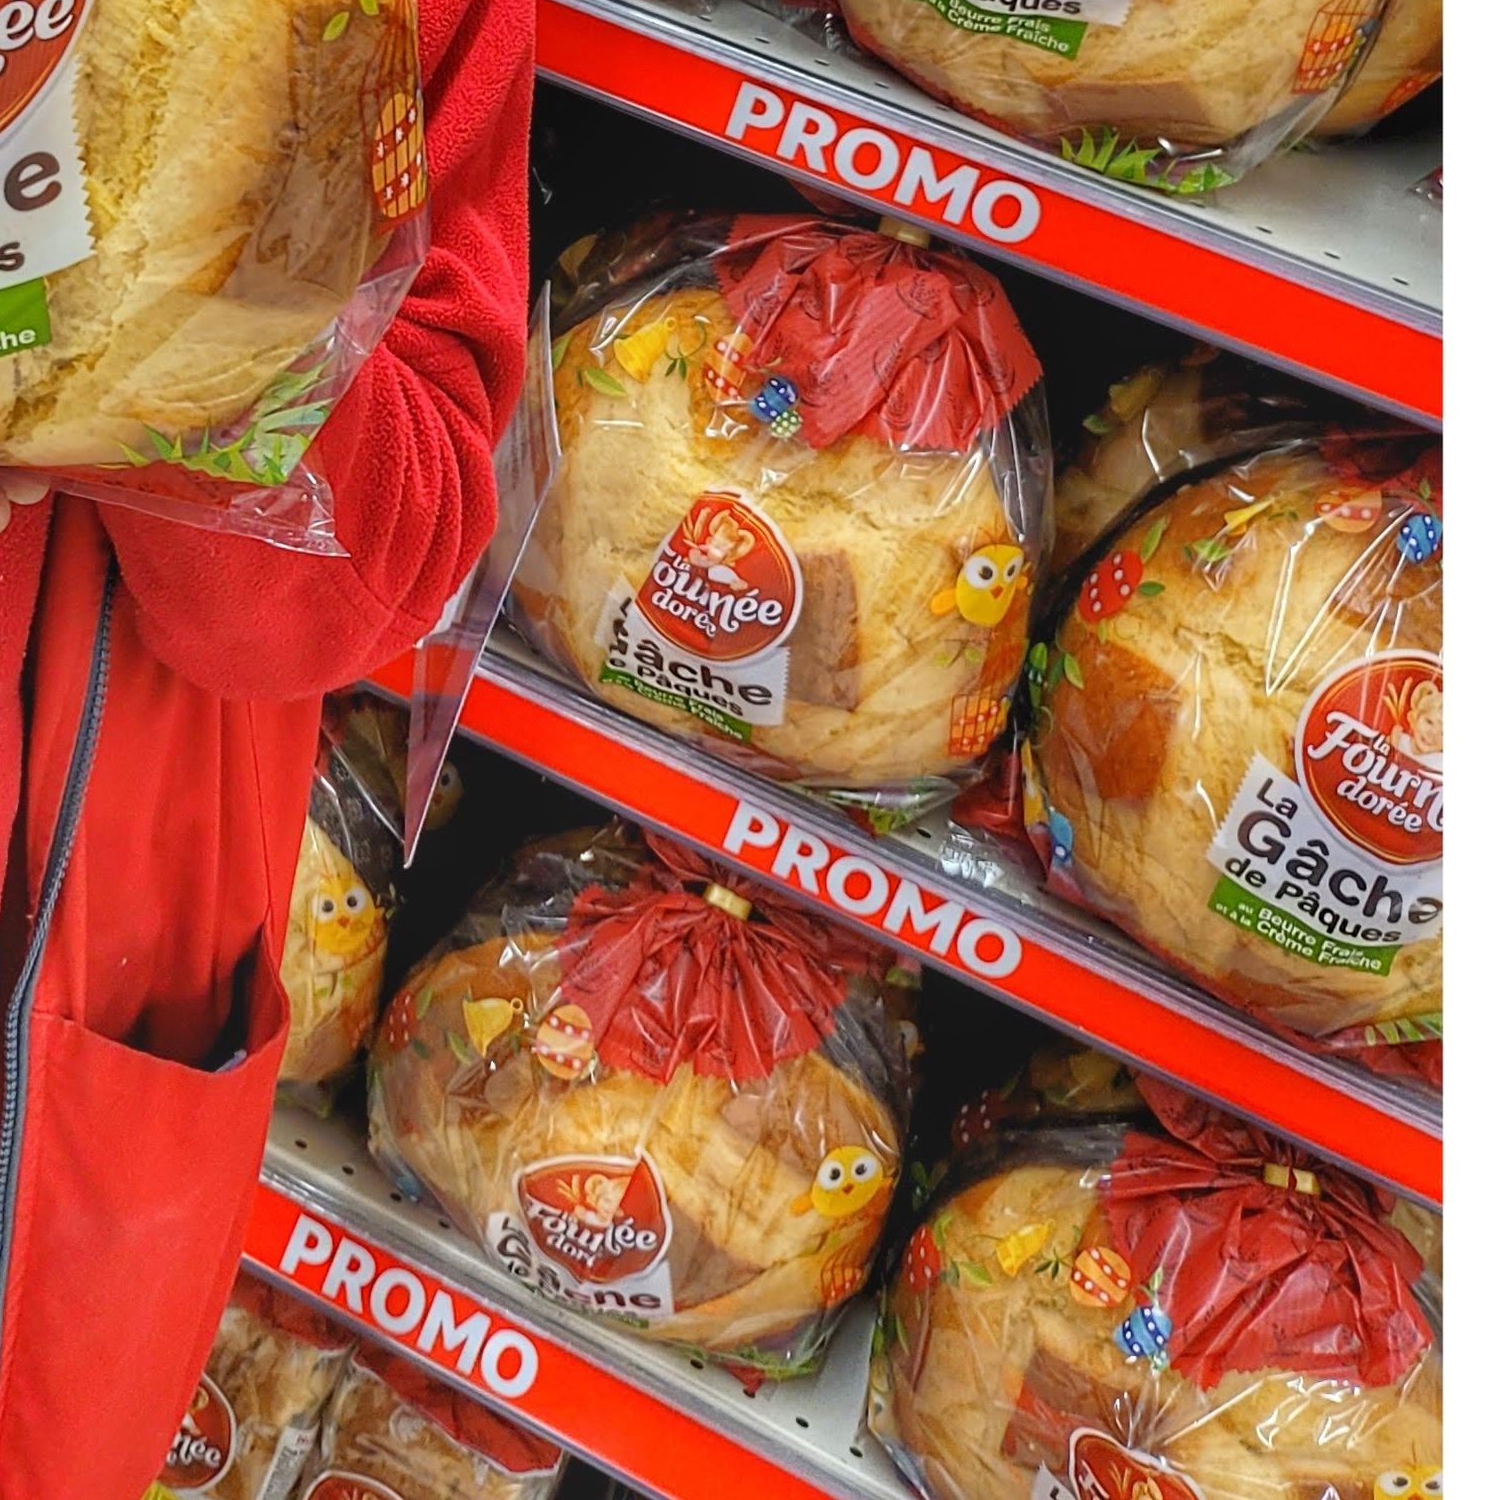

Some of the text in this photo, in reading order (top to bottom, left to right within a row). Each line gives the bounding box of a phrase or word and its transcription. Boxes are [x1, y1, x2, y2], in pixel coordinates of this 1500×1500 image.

[1007, 16, 1050, 32] Frais
[724, 80, 1042, 243] PROMO
[673, 555, 690, 571] la
[637, 665, 743, 716] Pâques
[1308, 711, 1443, 829] Fourn
[1373, 734, 1391, 754] la
[1256, 778, 1299, 820] La
[1337, 777, 1422, 834] dorée
[723, 800, 1022, 980] PROMO
[1238, 810, 1443, 925] Gâche
[1225, 857, 1402, 942] de Pâques
[1259, 908, 1317, 945] Beurre
[279, 1212, 540, 1399] PROMO
